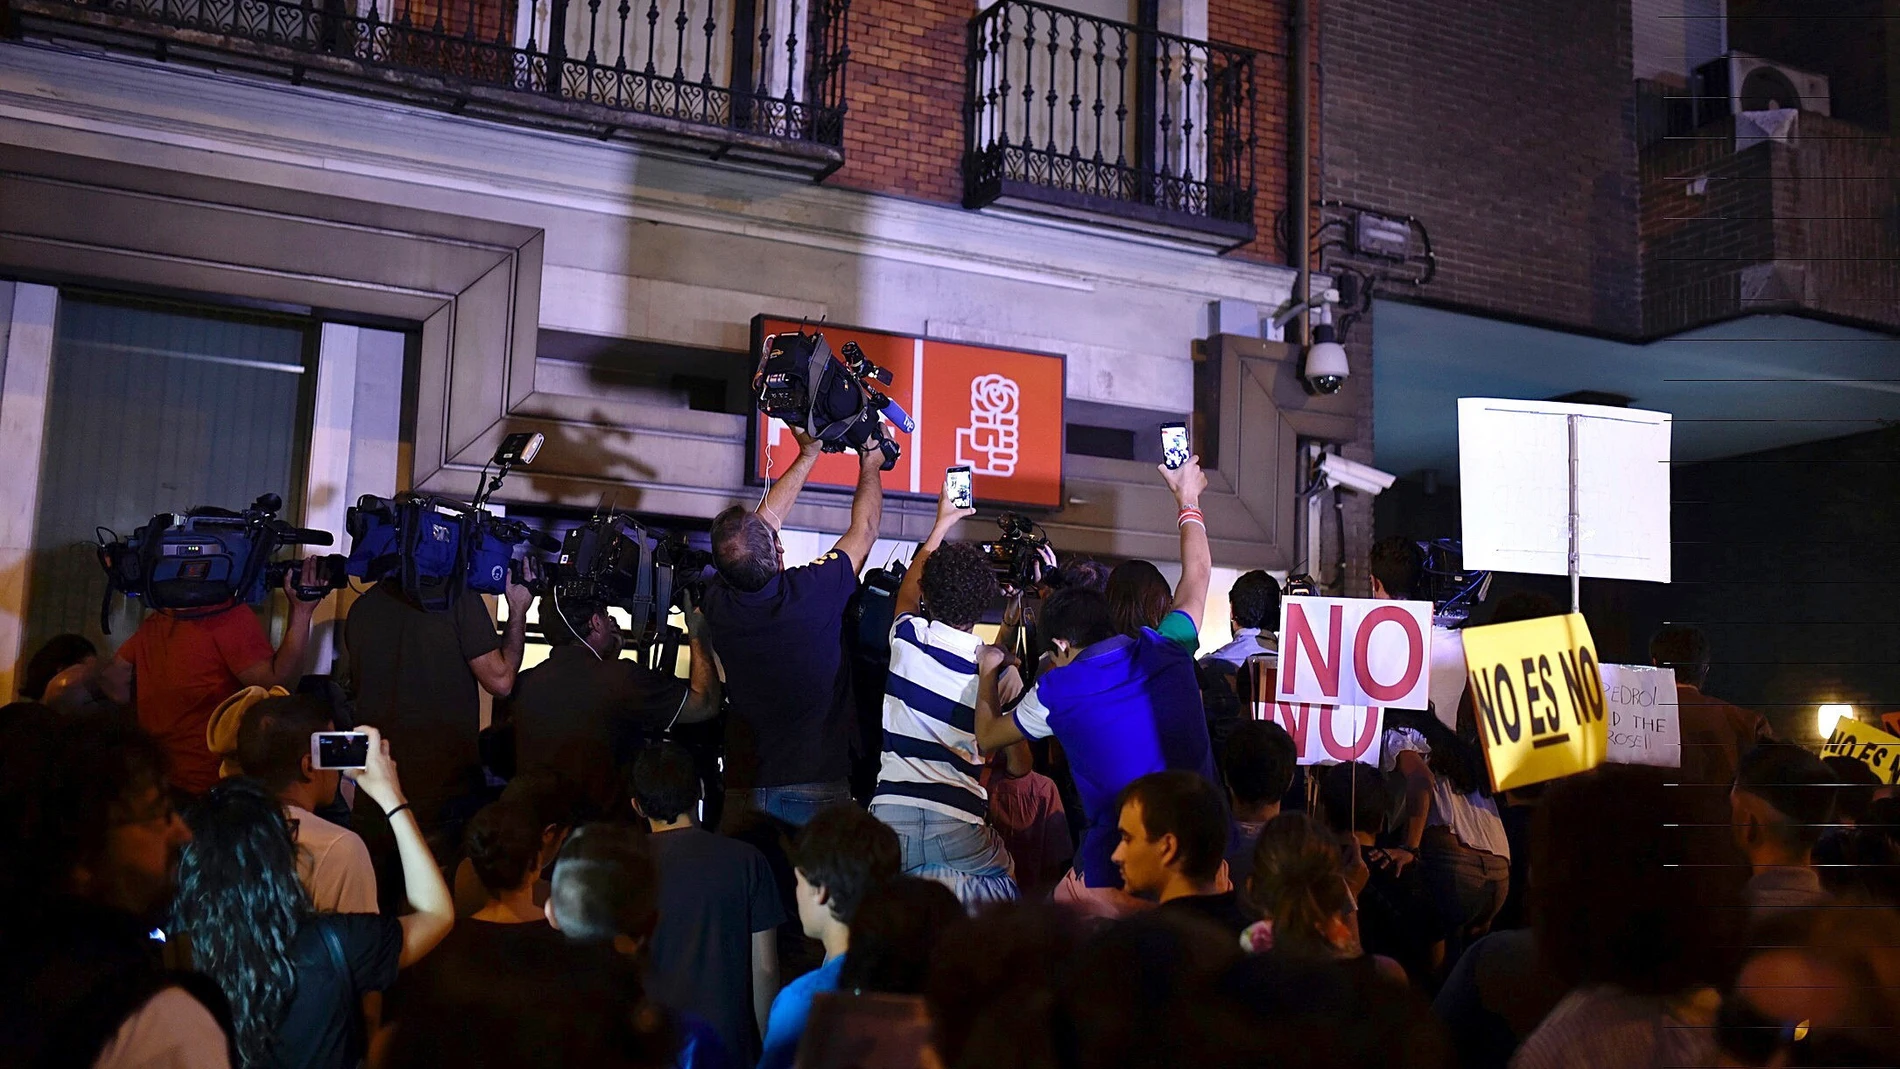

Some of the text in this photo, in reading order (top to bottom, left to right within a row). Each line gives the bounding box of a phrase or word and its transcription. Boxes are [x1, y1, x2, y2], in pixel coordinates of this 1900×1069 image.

[1282, 603, 1424, 702] NO
[1472, 645, 1604, 746] NO ES NO
[1633, 715, 1666, 733] THE
[1823, 729, 1857, 757] NO
